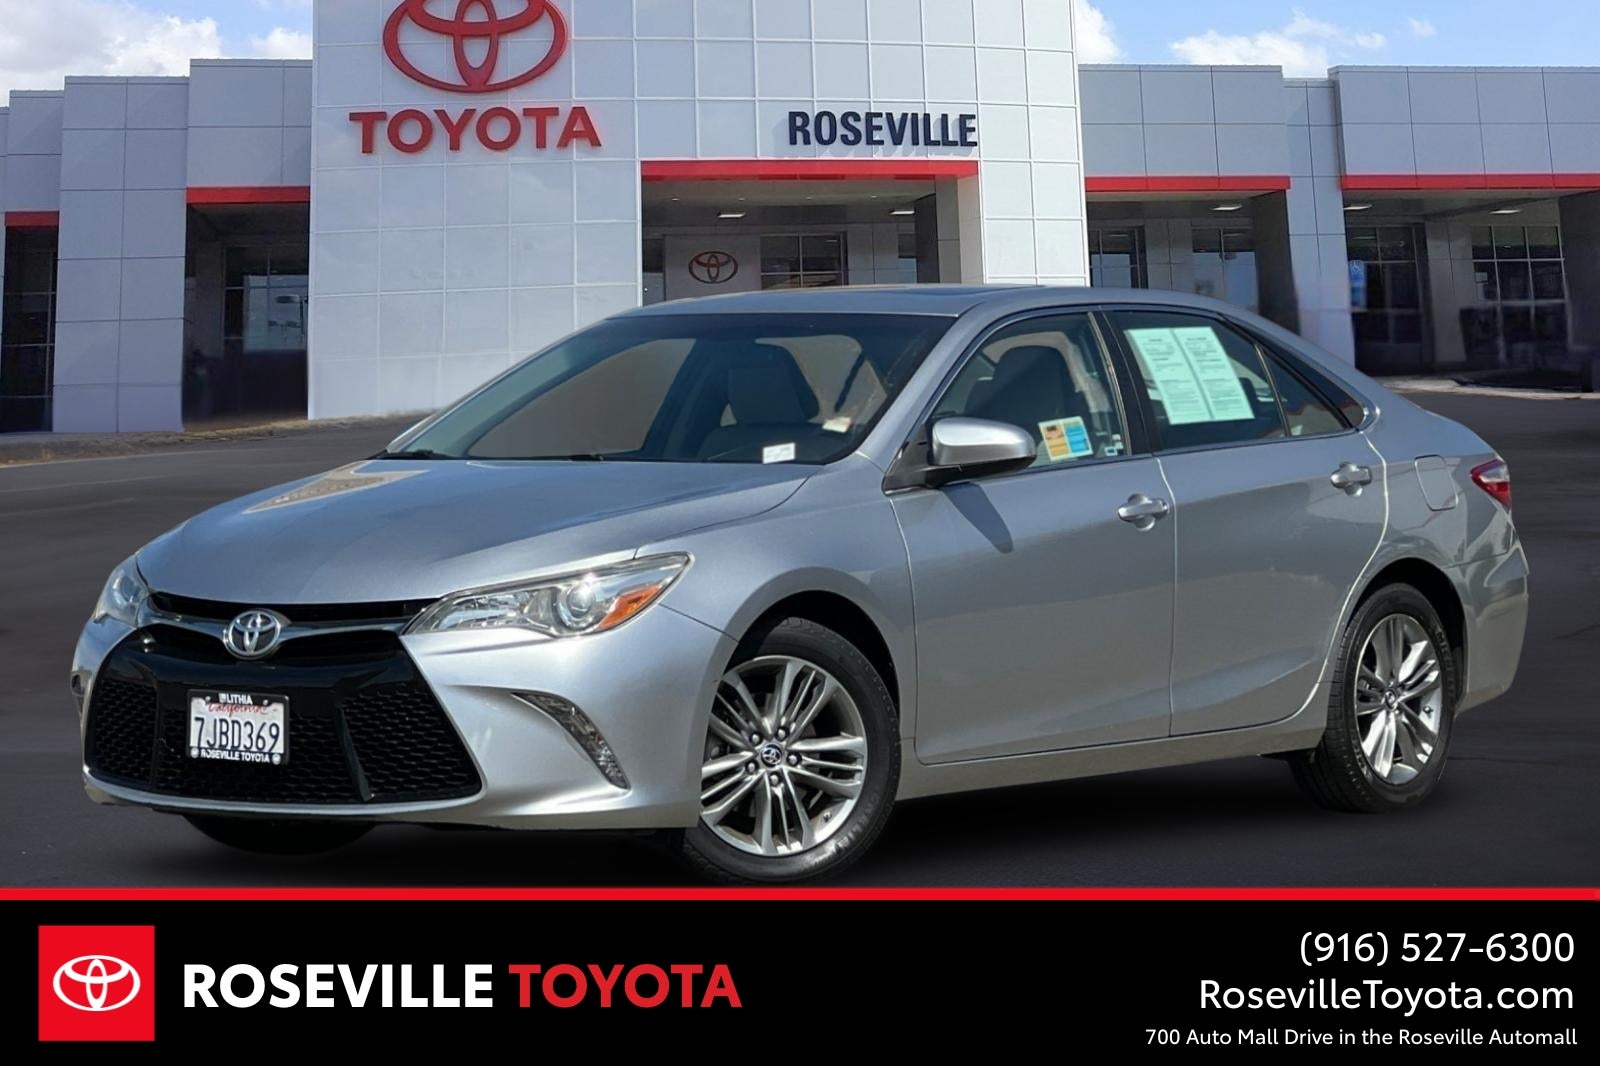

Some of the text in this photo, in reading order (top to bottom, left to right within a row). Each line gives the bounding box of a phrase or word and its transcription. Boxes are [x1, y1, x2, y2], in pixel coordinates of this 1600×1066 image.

[350, 106, 602, 154] TOYOTA
[787, 110, 979, 148] ROSEVILLE
[226, 693, 254, 705] LITHIA
[193, 716, 281, 753] 7JBD369
[200, 749, 271, 763] ROSEVILLE TOYOTA
